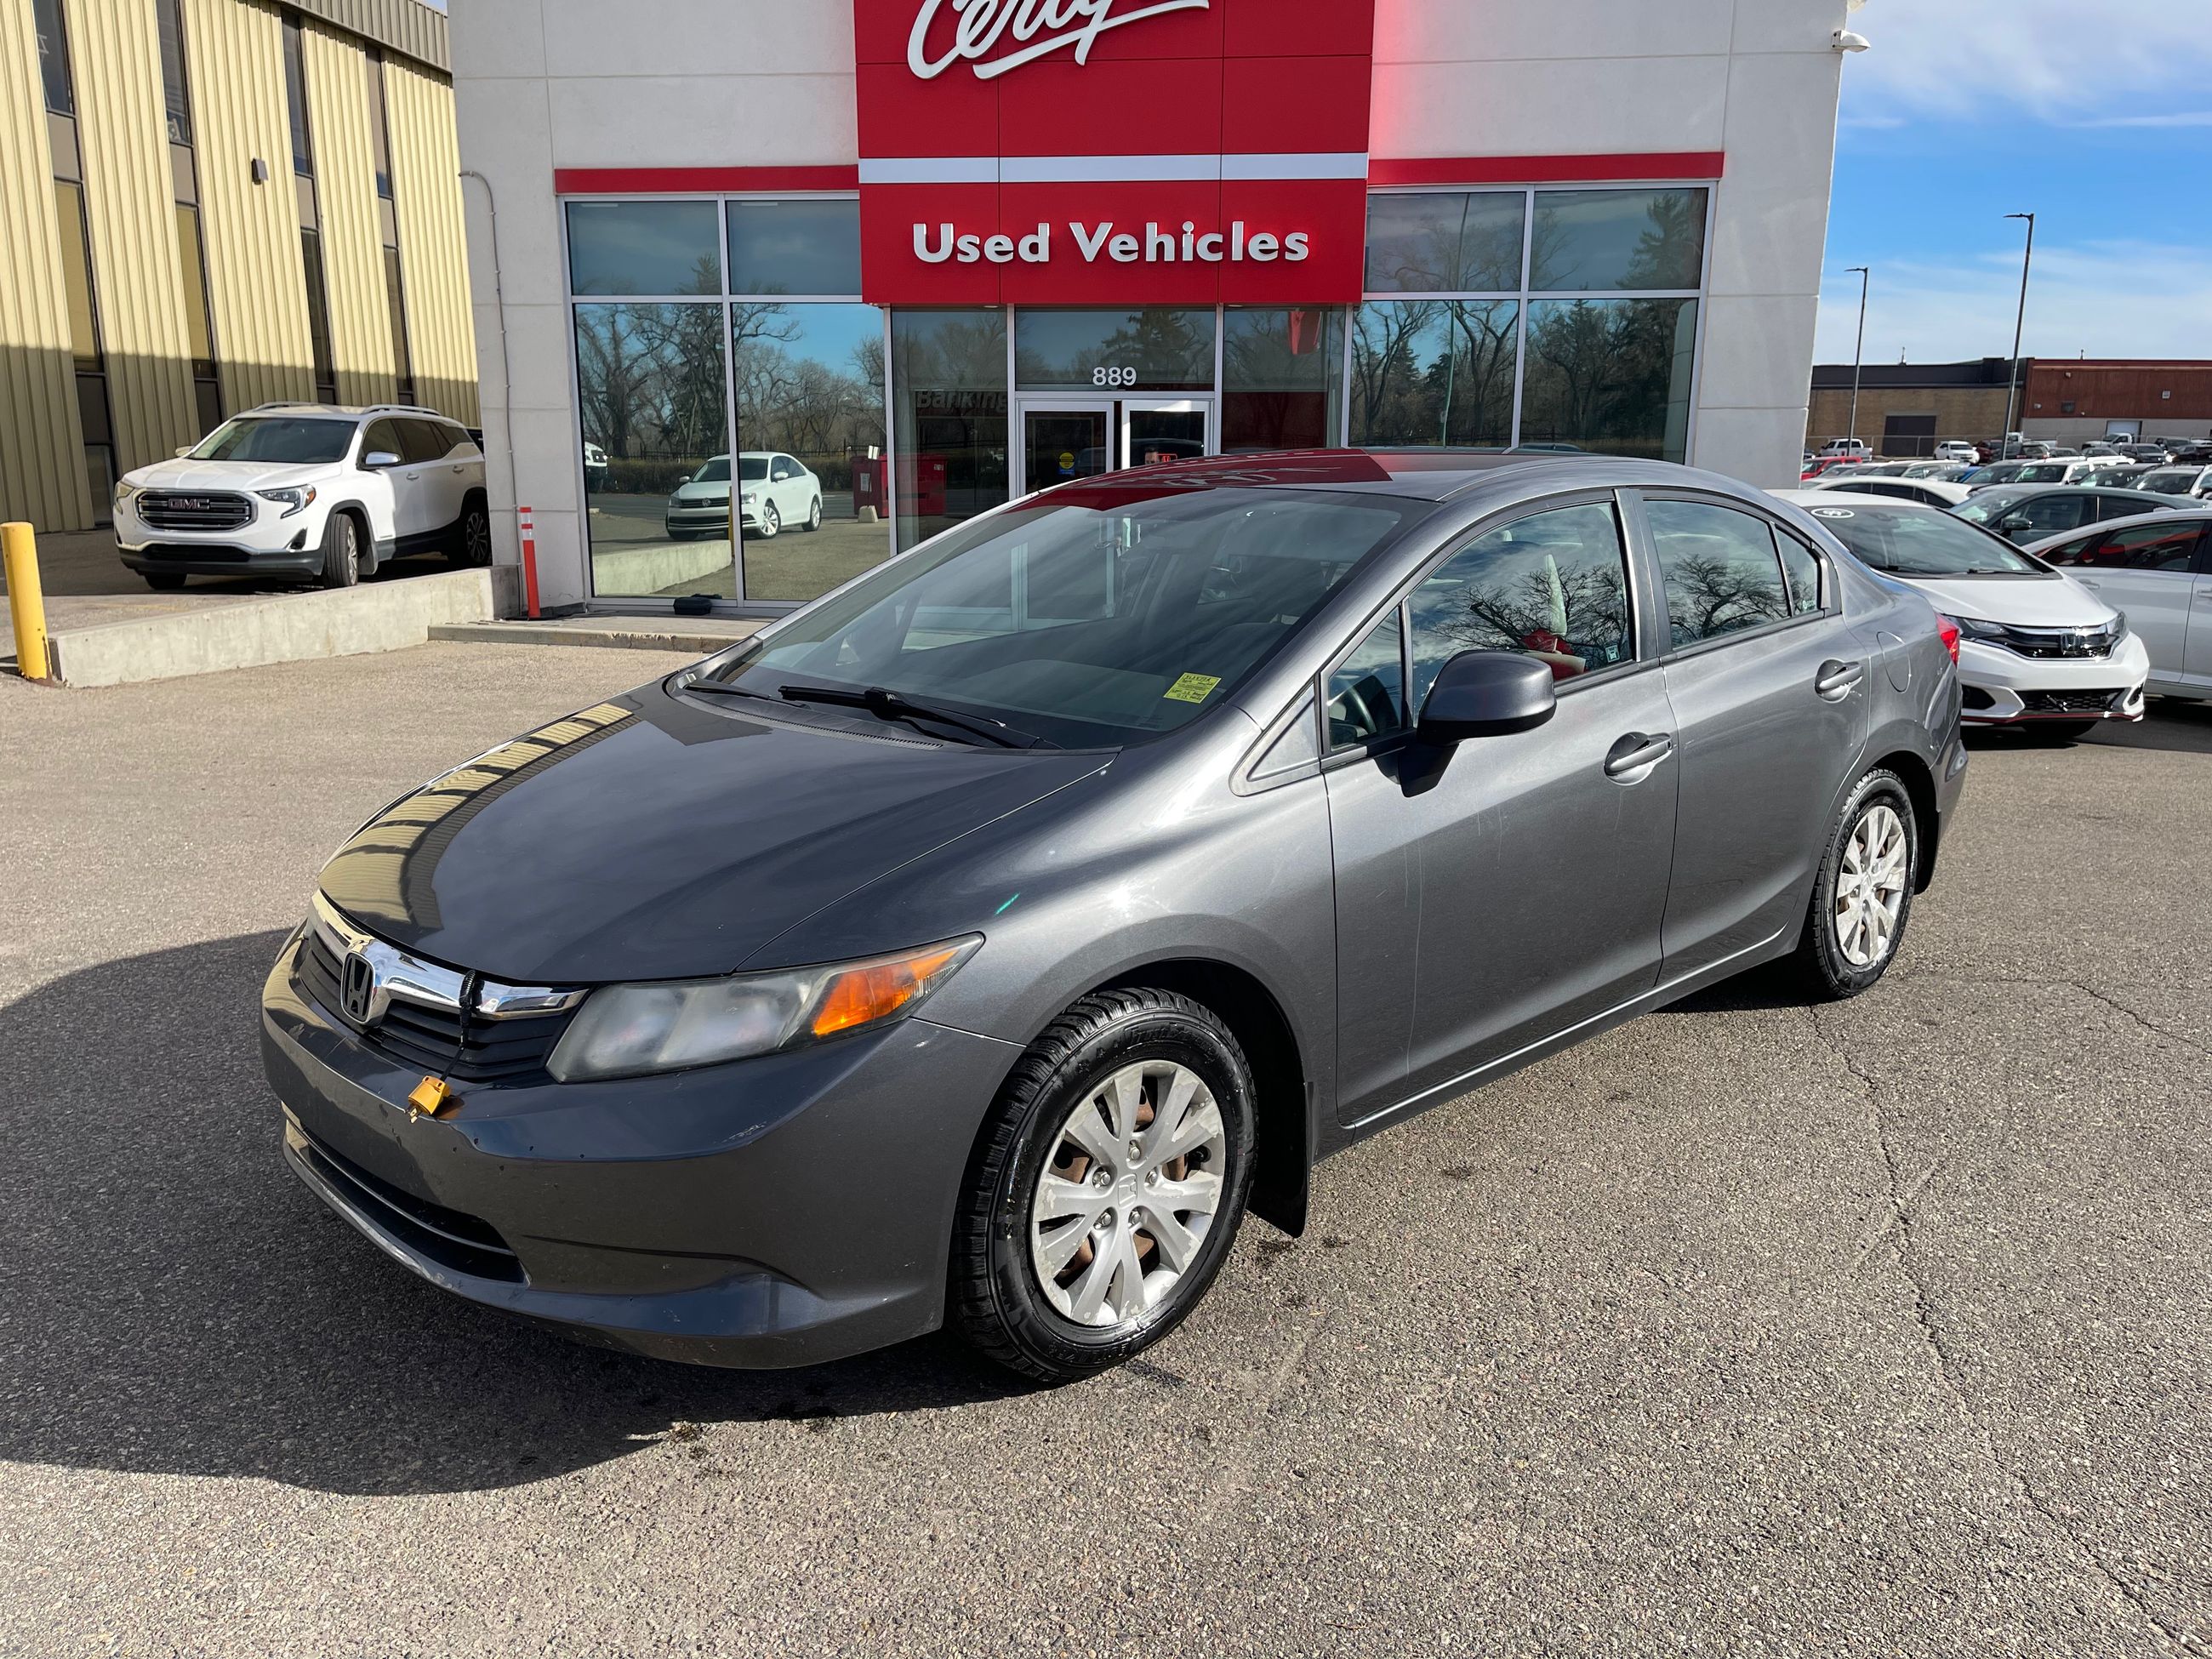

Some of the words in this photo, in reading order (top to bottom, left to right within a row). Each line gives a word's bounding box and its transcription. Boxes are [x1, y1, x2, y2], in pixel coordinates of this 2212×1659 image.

[913, 222, 1050, 263] Used
[1069, 220, 1308, 262] Vehicles
[1092, 366, 1137, 386] 889
[168, 498, 210, 510] GMC
